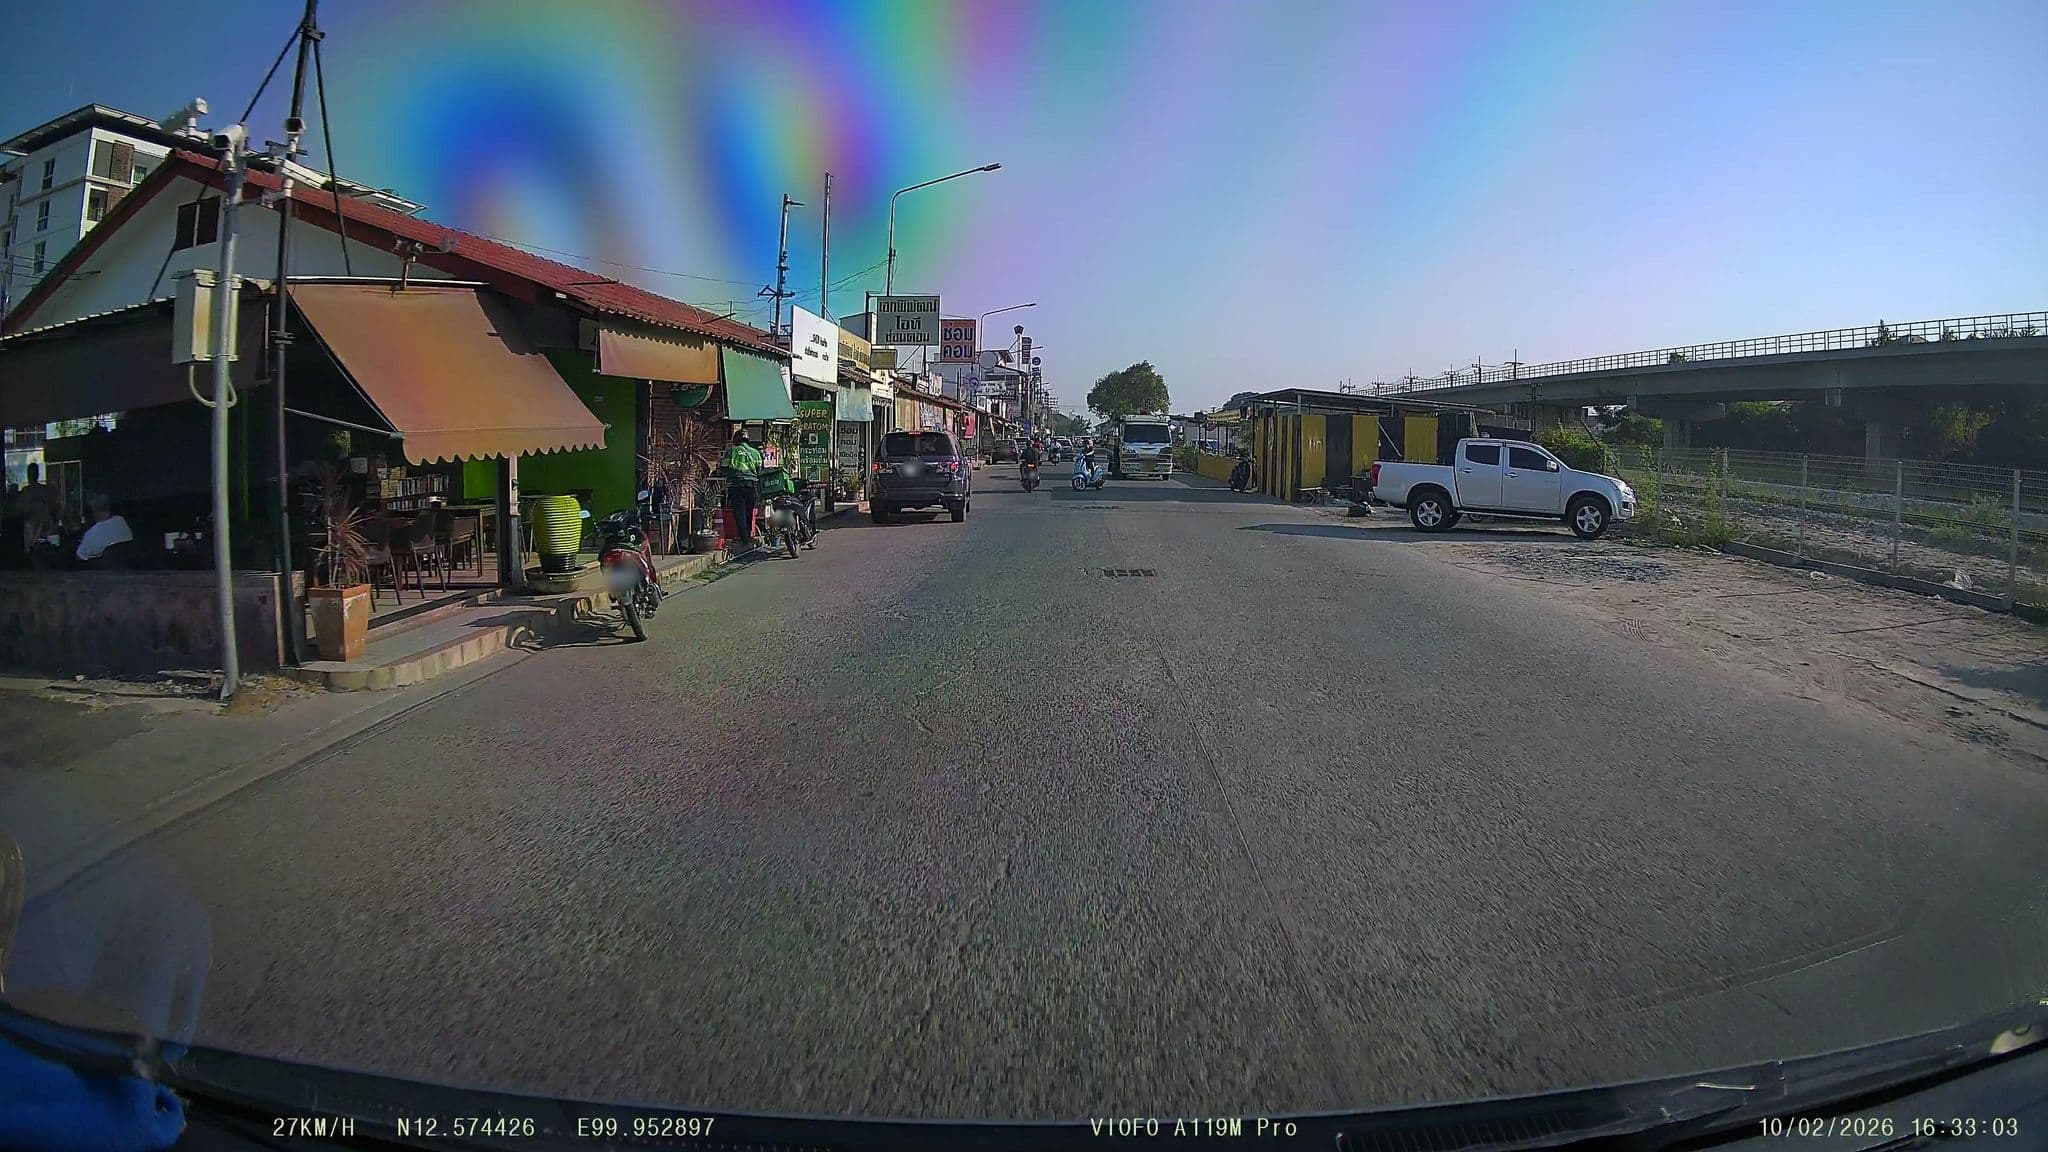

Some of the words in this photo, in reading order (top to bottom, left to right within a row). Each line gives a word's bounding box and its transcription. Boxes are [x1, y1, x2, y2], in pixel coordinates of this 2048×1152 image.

[895, 315, 921, 330] ไอที
[885, 329, 930, 343] ซ่อมคอม
[943, 322, 973, 341] ซ่อม
[943, 345, 973, 359] คอม
[800, 408, 828, 418] SUPER
[799, 422, 828, 431] RATOM
